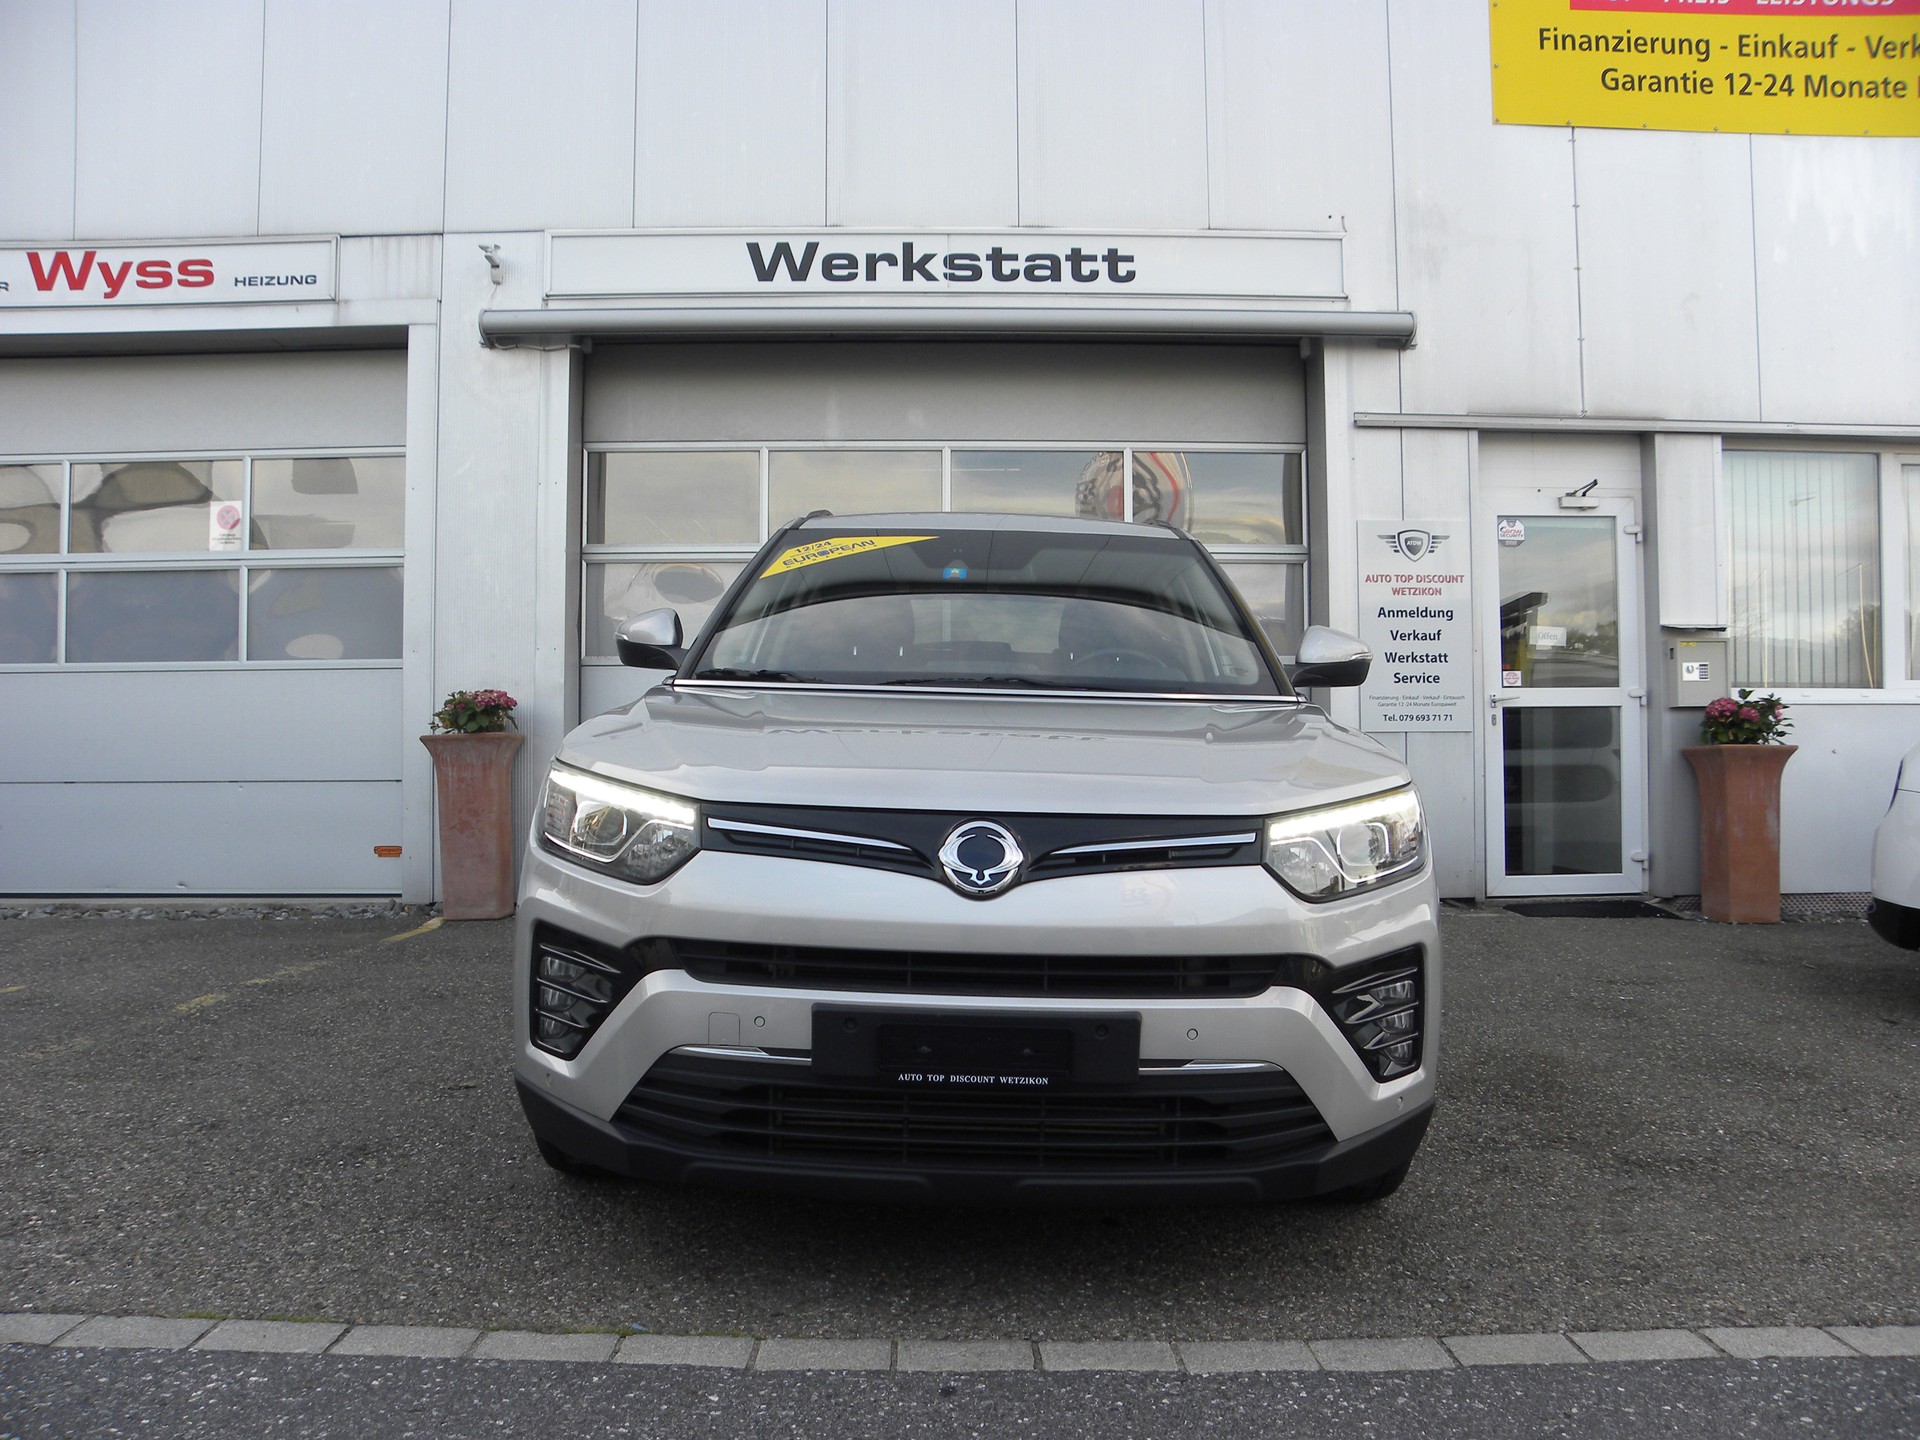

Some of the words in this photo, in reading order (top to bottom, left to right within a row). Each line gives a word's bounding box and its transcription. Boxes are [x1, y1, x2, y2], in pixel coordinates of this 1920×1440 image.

[1538, 27, 1710, 62] Finanzierung
[1737, 33, 1839, 58] Einkauf
[1600, 67, 1714, 95] Garantie
[1723, 72, 1795, 97] 12-24
[1804, 74, 1908, 99] Monate
[745, 241, 1137, 284] Werkstatt
[26, 250, 215, 299] Wyss
[234, 274, 318, 288] HEIZUNG
[782, 540, 876, 566] EUROPEAN
[795, 541, 832, 553] 12/24
[1365, 574, 1392, 583] AUTO
[1394, 574, 1414, 583] TOP
[1416, 574, 1465, 584] DISCOUNT
[1391, 587, 1442, 596] WETZIKON
[1377, 606, 1454, 621] Anmeldung
[1390, 629, 1442, 641] Verkauf
[1384, 652, 1449, 664] Werkstatt
[1393, 672, 1441, 684] Service
[1383, 714, 1398, 722] Tel.
[1399, 714, 1414, 722] 079
[1415, 714, 1431, 722] 693
[1432, 714, 1442, 722] 71
[1443, 714, 1453, 722] 71
[898, 1073, 923, 1082] AUTO
[926, 1074, 946, 1082] TOP
[949, 1074, 996, 1084] DISCOUNT
[999, 1076, 1049, 1085] WETZIKON
